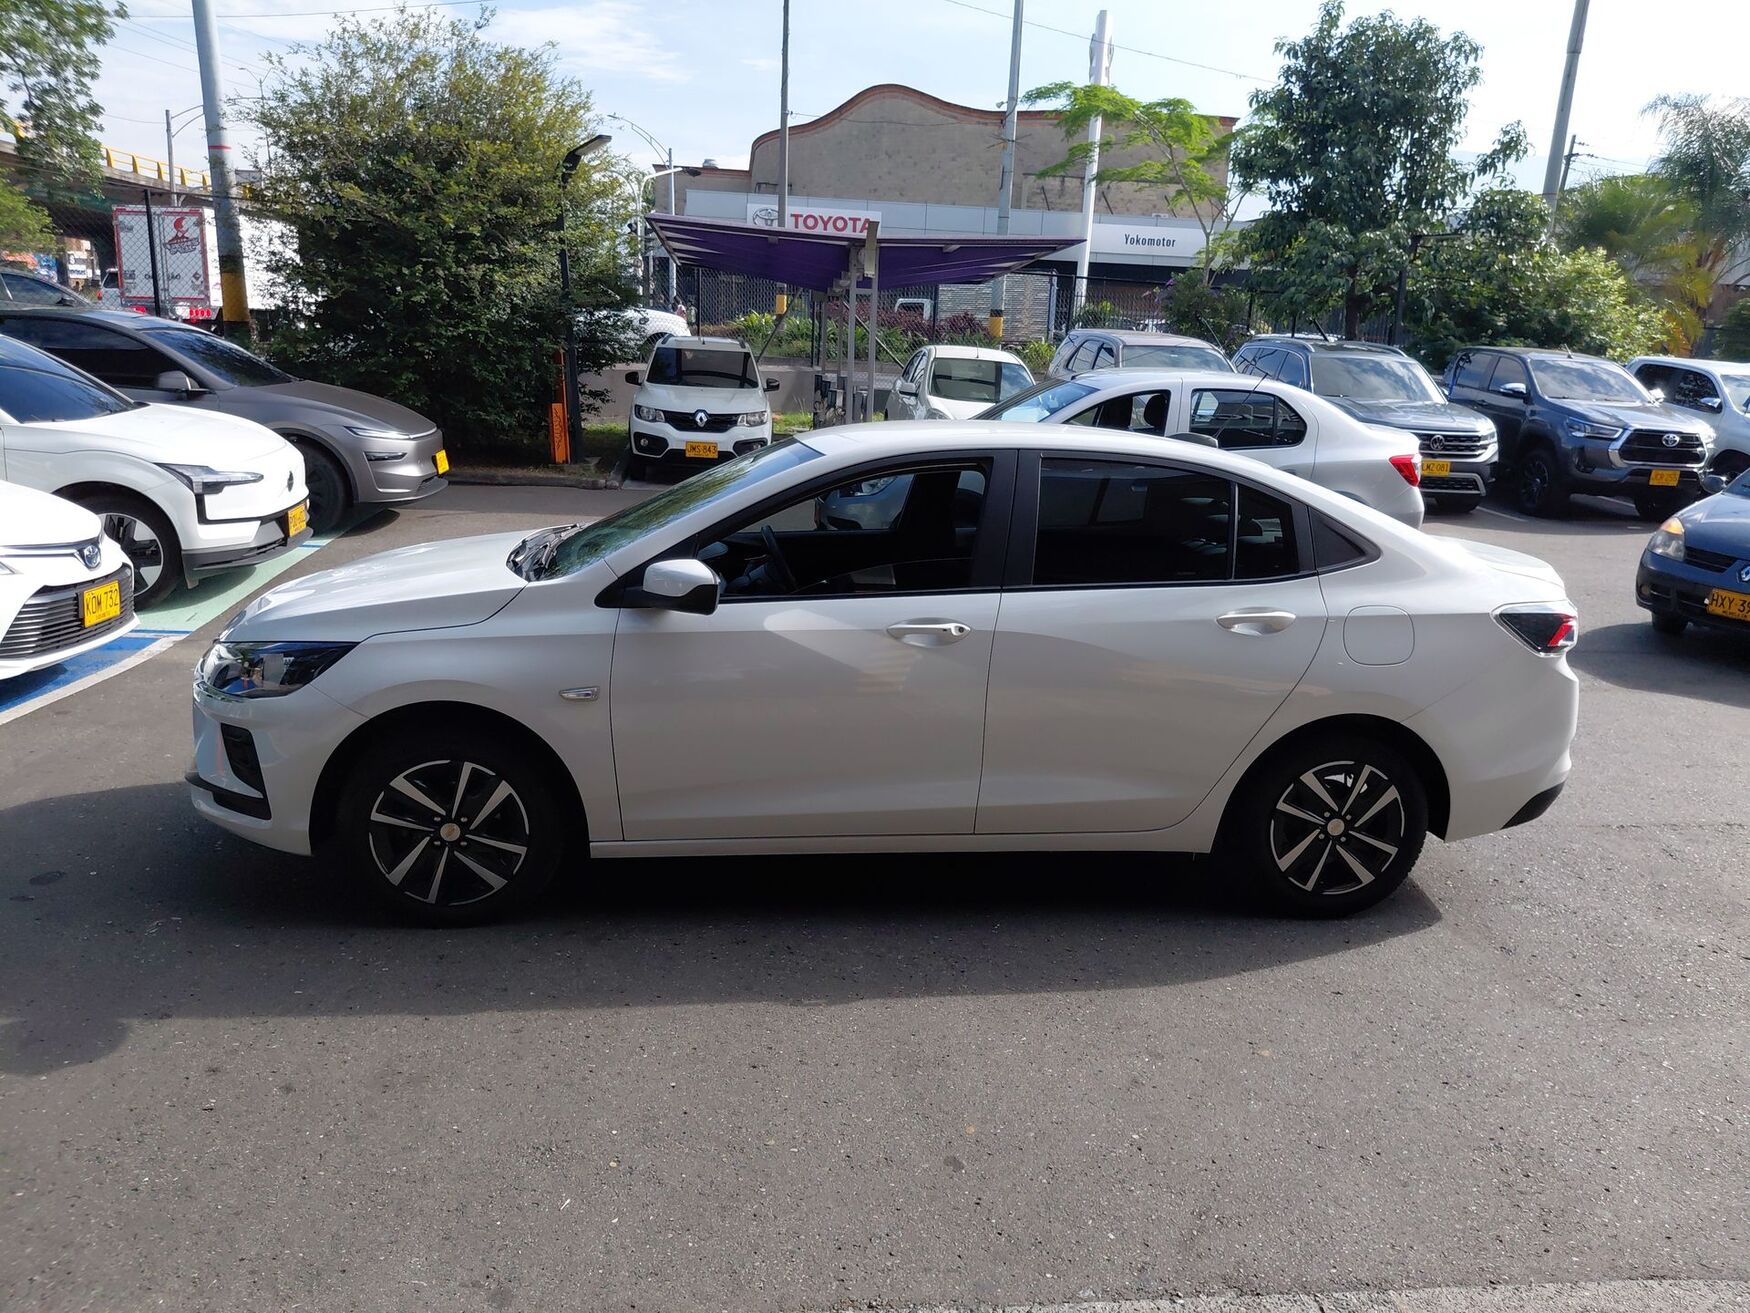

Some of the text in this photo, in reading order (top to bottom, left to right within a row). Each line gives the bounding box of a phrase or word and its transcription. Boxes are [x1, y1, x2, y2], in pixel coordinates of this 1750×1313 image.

[790, 212, 872, 233] TOYOTA
[1124, 233, 1176, 248] Yokomotor
[702, 445, 717, 454] 843
[104, 588, 119, 610] 732
[1711, 592, 1735, 610] HXY
